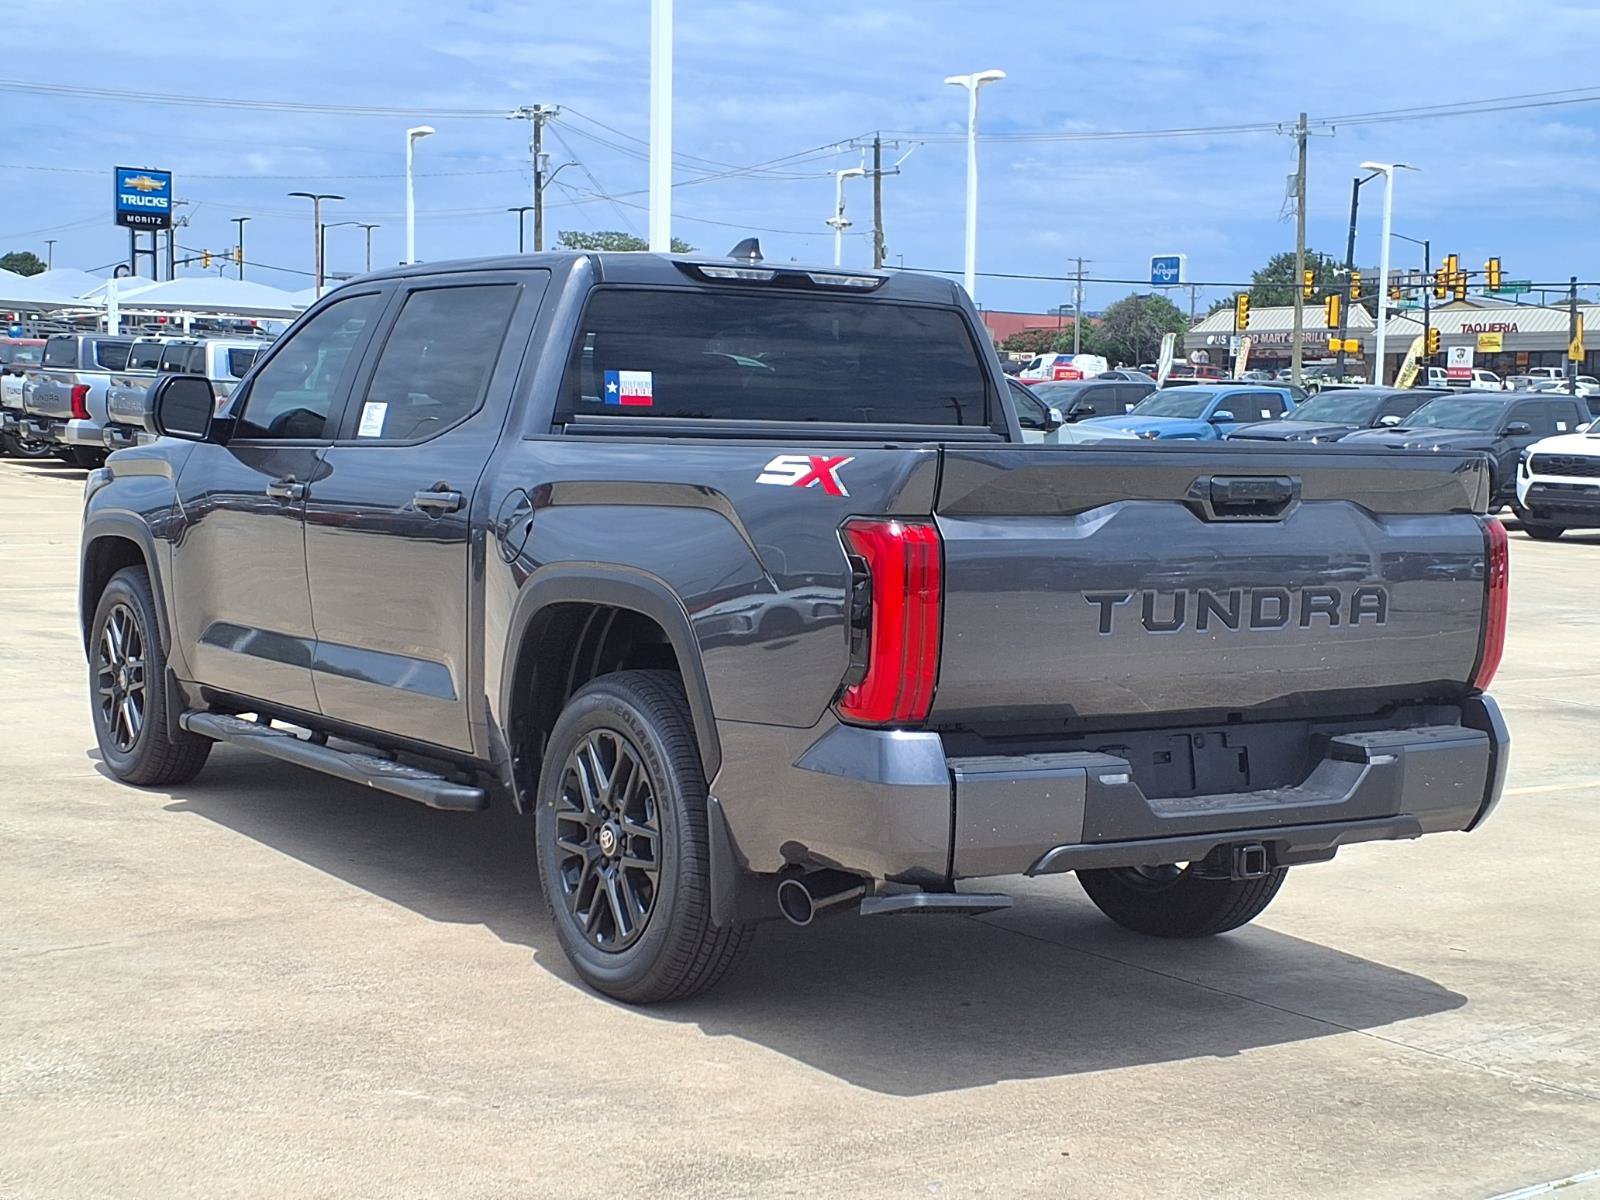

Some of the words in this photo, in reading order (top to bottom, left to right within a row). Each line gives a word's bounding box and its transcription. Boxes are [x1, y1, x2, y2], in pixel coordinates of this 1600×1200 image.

[120, 194, 168, 208] TRUCKS
[126, 214, 163, 225] MORITZ
[1152, 262, 1178, 280] Kroger
[1461, 323, 1519, 334] TAQUERIA
[1214, 335, 1227, 344] US
[1261, 333, 1288, 344] MART
[1080, 586, 1389, 635] TUNDRA
